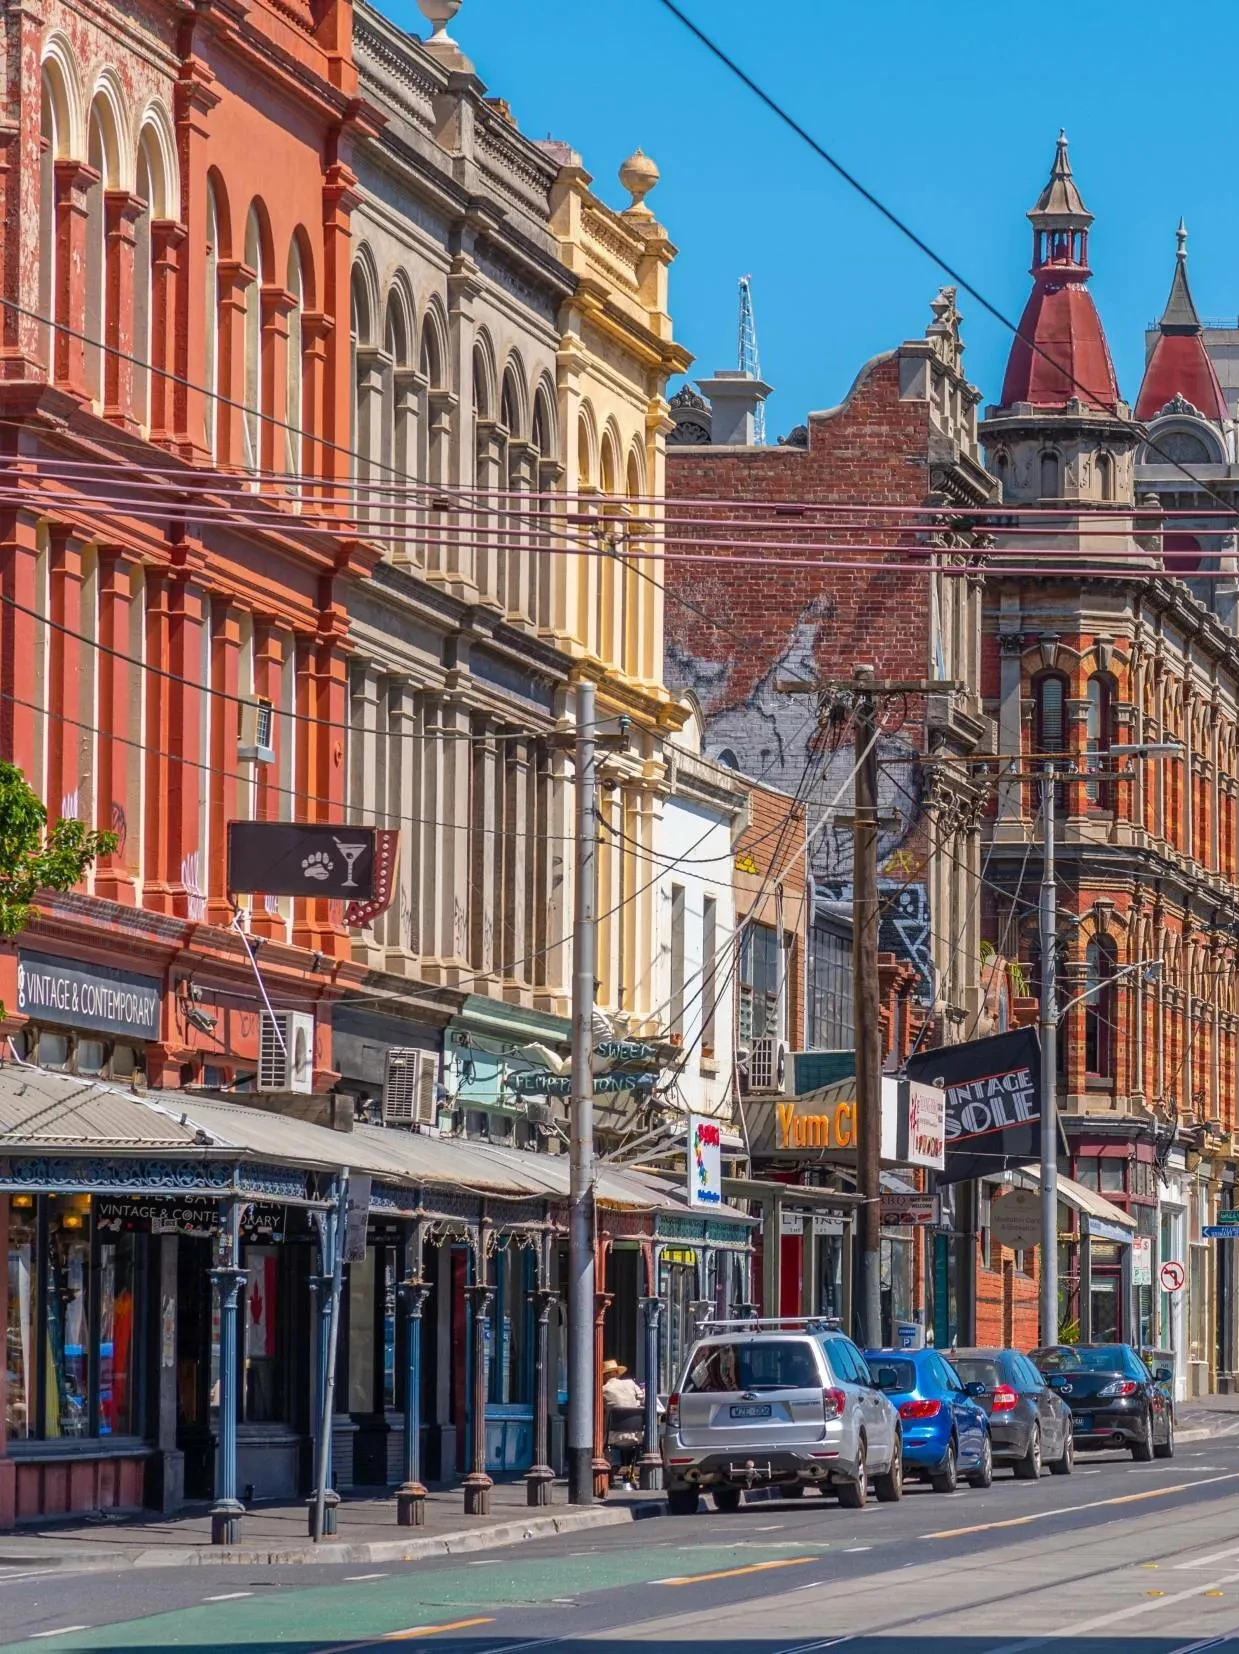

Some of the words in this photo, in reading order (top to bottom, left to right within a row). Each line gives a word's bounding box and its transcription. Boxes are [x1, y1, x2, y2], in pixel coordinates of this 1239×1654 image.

[26, 971, 70, 1010] VINTAGE
[71, 982, 79, 1012] &
[80, 983, 156, 1027] CONTEMPORARY
[777, 1102, 830, 1148] Yum
[100, 1203, 156, 1218] VINTAGE
[160, 1208, 169, 1219] &
